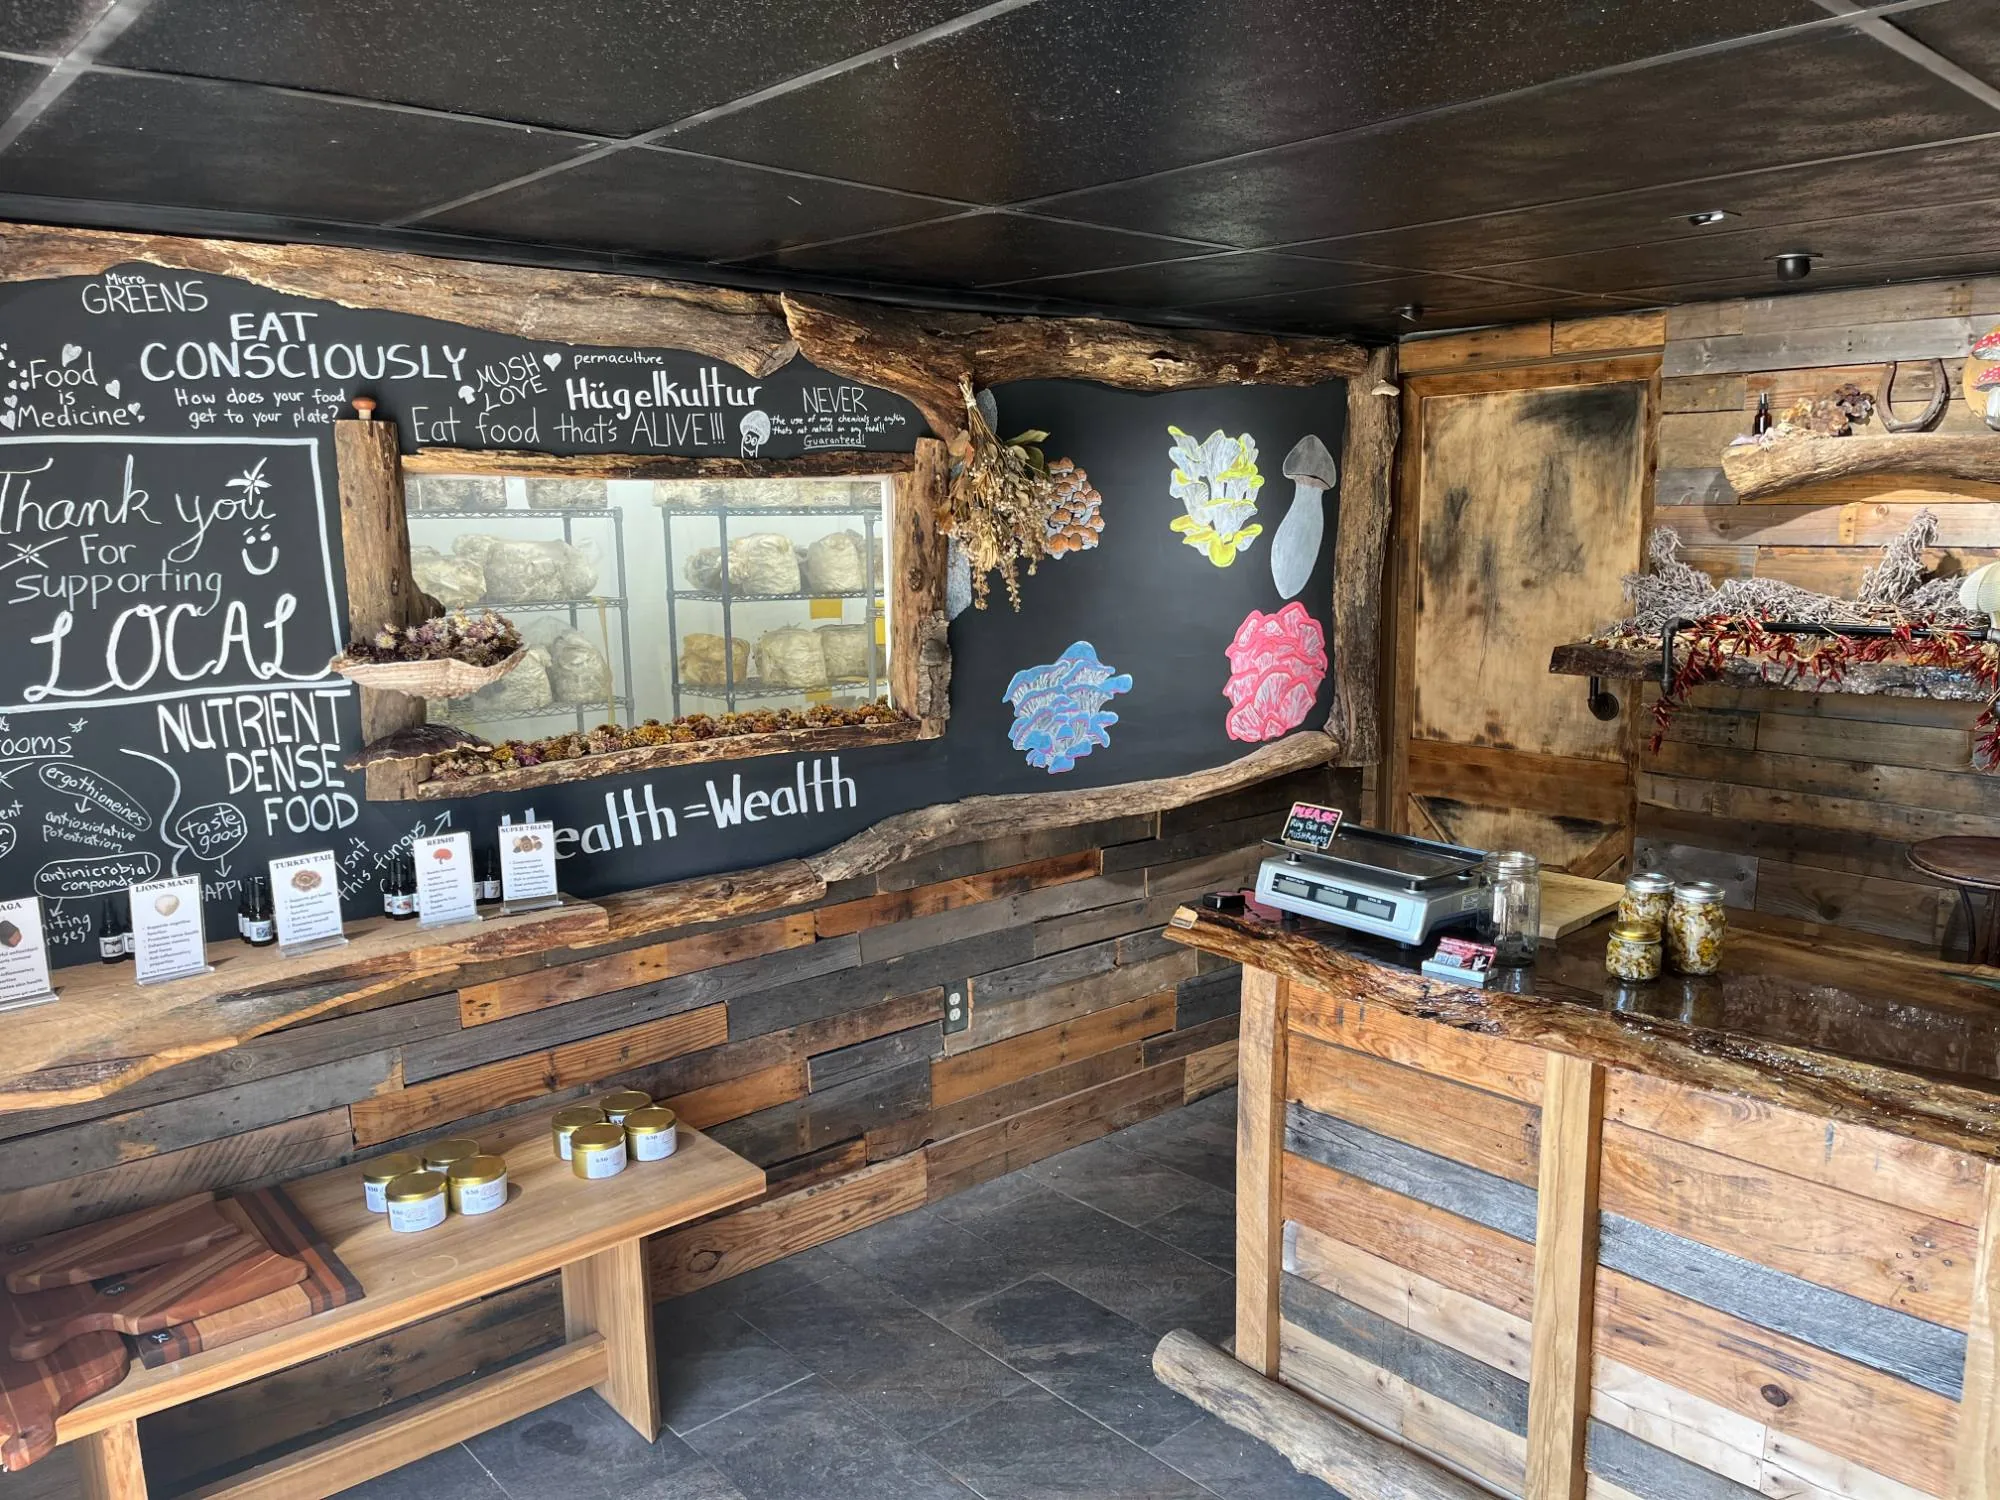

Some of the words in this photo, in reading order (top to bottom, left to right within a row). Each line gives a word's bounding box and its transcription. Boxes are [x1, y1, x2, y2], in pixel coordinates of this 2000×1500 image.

[106, 273, 145, 286] Micro
[81, 280, 208, 314] GREENS
[229, 311, 318, 343] EAT
[30, 351, 98, 389] Food
[140, 341, 467, 382] CONSCIOUSLY
[476, 352, 541, 393] MUSH
[573, 351, 664, 370] permaculture
[58, 389, 76, 405] is
[174, 388, 216, 407] How
[226, 388, 265, 405] does
[273, 391, 304, 407] your
[312, 388, 346, 405] food
[485, 374, 548, 412] LOVE
[565, 366, 762, 421] Hügelkultur
[802, 386, 868, 413] NEVER
[18, 404, 131, 428] Medicine
[188, 408, 217, 430] get
[224, 408, 244, 424] to
[252, 411, 282, 428] your
[293, 404, 339, 428] plate?
[411, 406, 461, 443] Eat
[475, 406, 540, 444] food
[553, 412, 617, 445] that's
[630, 410, 726, 447] ALIVE!!!
[770, 414, 786, 425] the
[790, 417, 804, 425] use
[807, 414, 816, 423] of
[838, 414, 870, 424] chemicals
[797, 425, 808, 433] not
[811, 424, 833, 433] natural
[803, 434, 865, 447] Guaranteed!
[0, 454, 162, 534] Thank
[168, 493, 277, 563] you
[80, 534, 137, 564] For
[23, 593, 333, 701] LOCAL
[157, 689, 351, 753] NUTRIENT
[0, 736, 72, 756] ooms
[225, 743, 345, 795] DENSE
[181, 806, 242, 838] taste
[264, 792, 359, 836] FOOD
[502, 783, 678, 861] ealth
[705, 756, 857, 829] Wealth
[1292, 806, 1338, 825] PLEASE
[200, 824, 243, 854] good
[40, 854, 152, 882] antimicrobial
[273, 858, 311, 870] TURKEY
[314, 853, 333, 862] TAIL
[61, 875, 135, 893] compounds
[135, 881, 166, 893] LIONS
[168, 878, 197, 888] MANE
[337, 869, 372, 902] this
